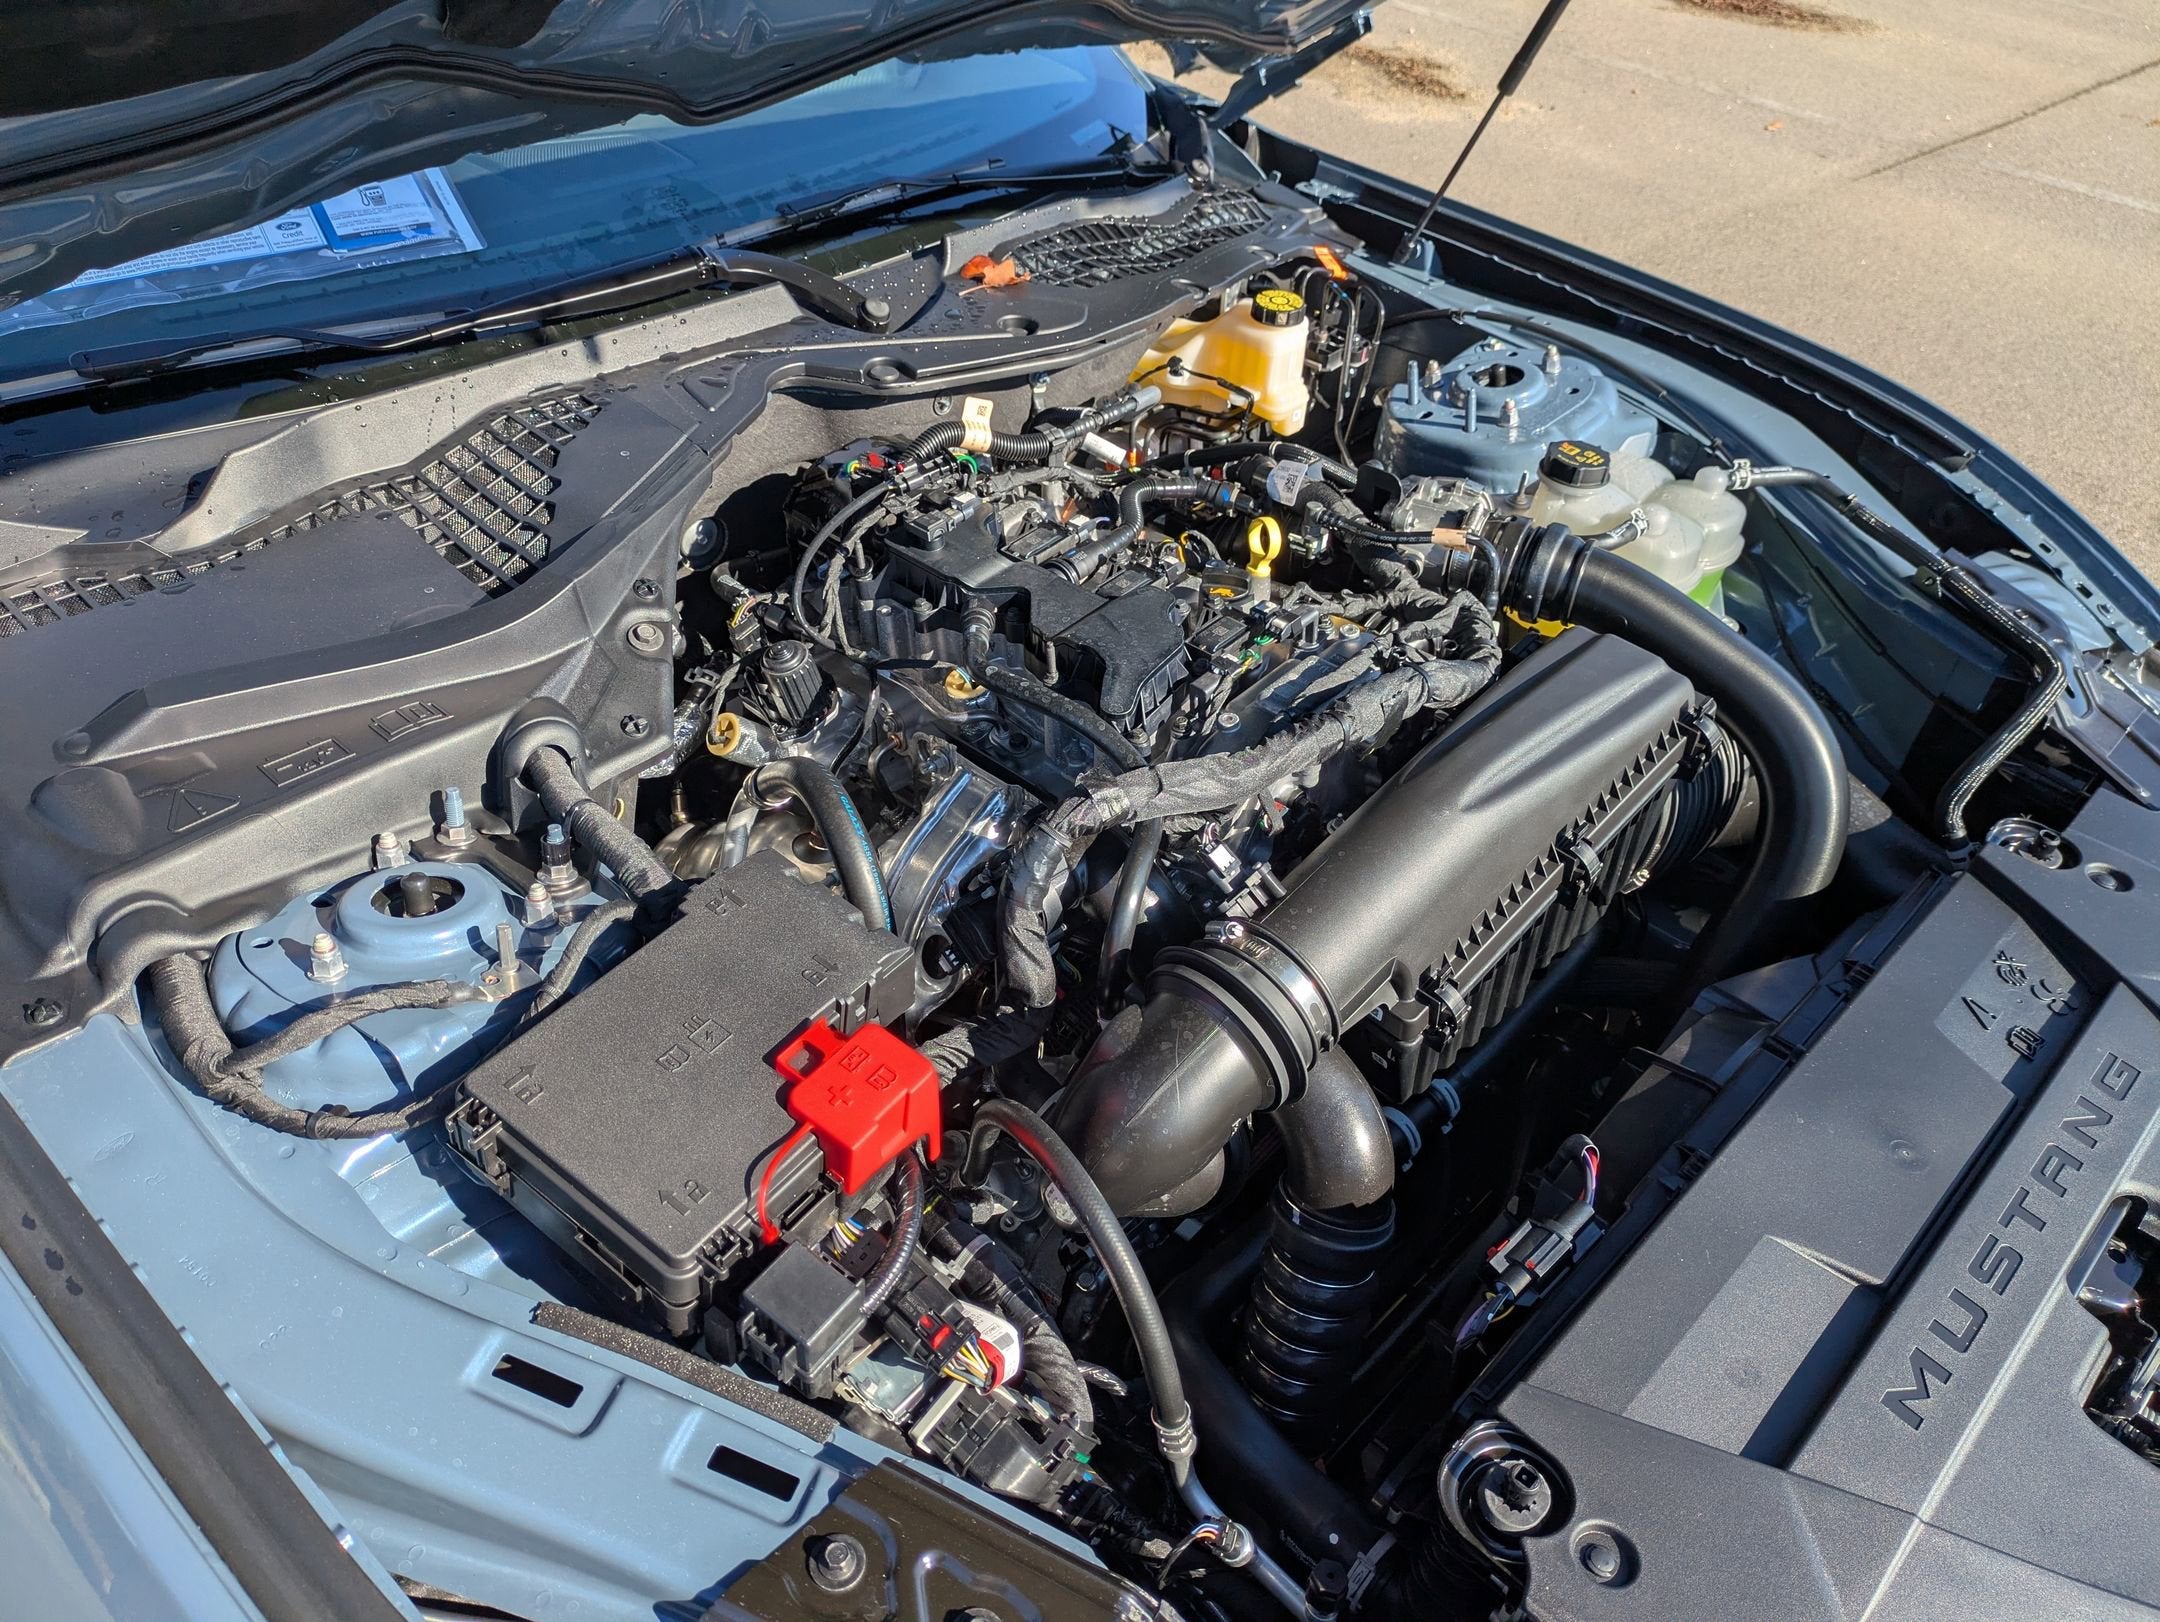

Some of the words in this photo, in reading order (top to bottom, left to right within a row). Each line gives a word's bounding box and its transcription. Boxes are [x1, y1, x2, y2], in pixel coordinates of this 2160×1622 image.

[279, 222, 299, 231] Ford
[281, 230, 303, 239] Credit
[839, 795, 865, 838] GALAXY
[1879, 1051, 2142, 1431] MUSTANG
